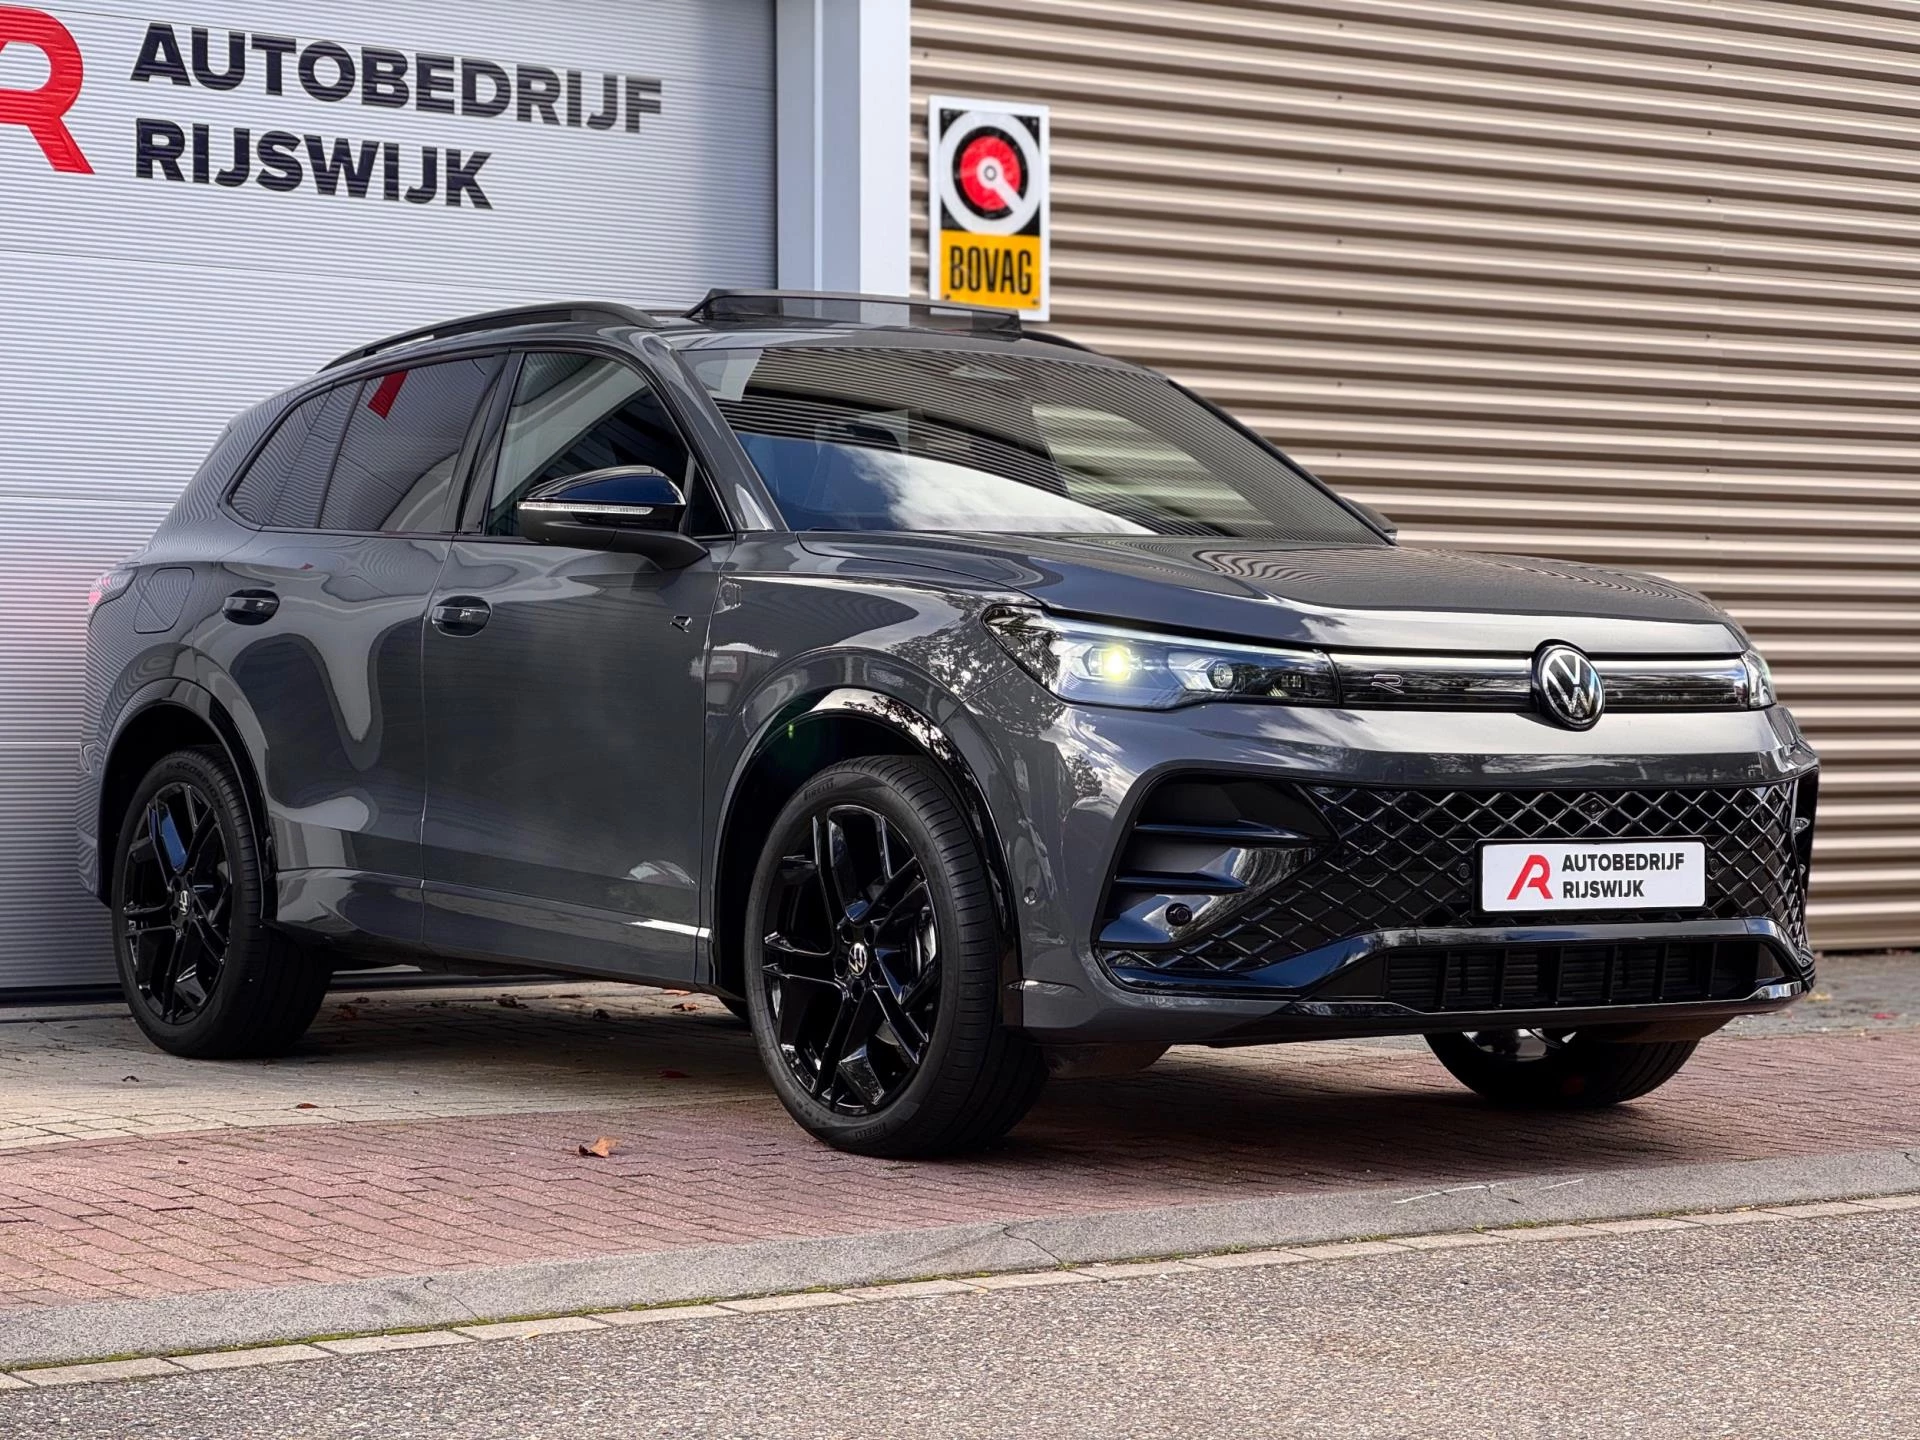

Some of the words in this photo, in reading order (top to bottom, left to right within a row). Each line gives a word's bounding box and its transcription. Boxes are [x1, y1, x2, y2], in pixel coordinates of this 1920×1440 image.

[130, 22, 662, 134] AUTOBEDRIJF
[135, 117, 494, 210] RIJSWIJK
[949, 245, 1032, 295] BOVAG
[1562, 852, 1685, 872] AUTOBEDRIJF
[1563, 880, 1645, 899] RIJSWIJK
